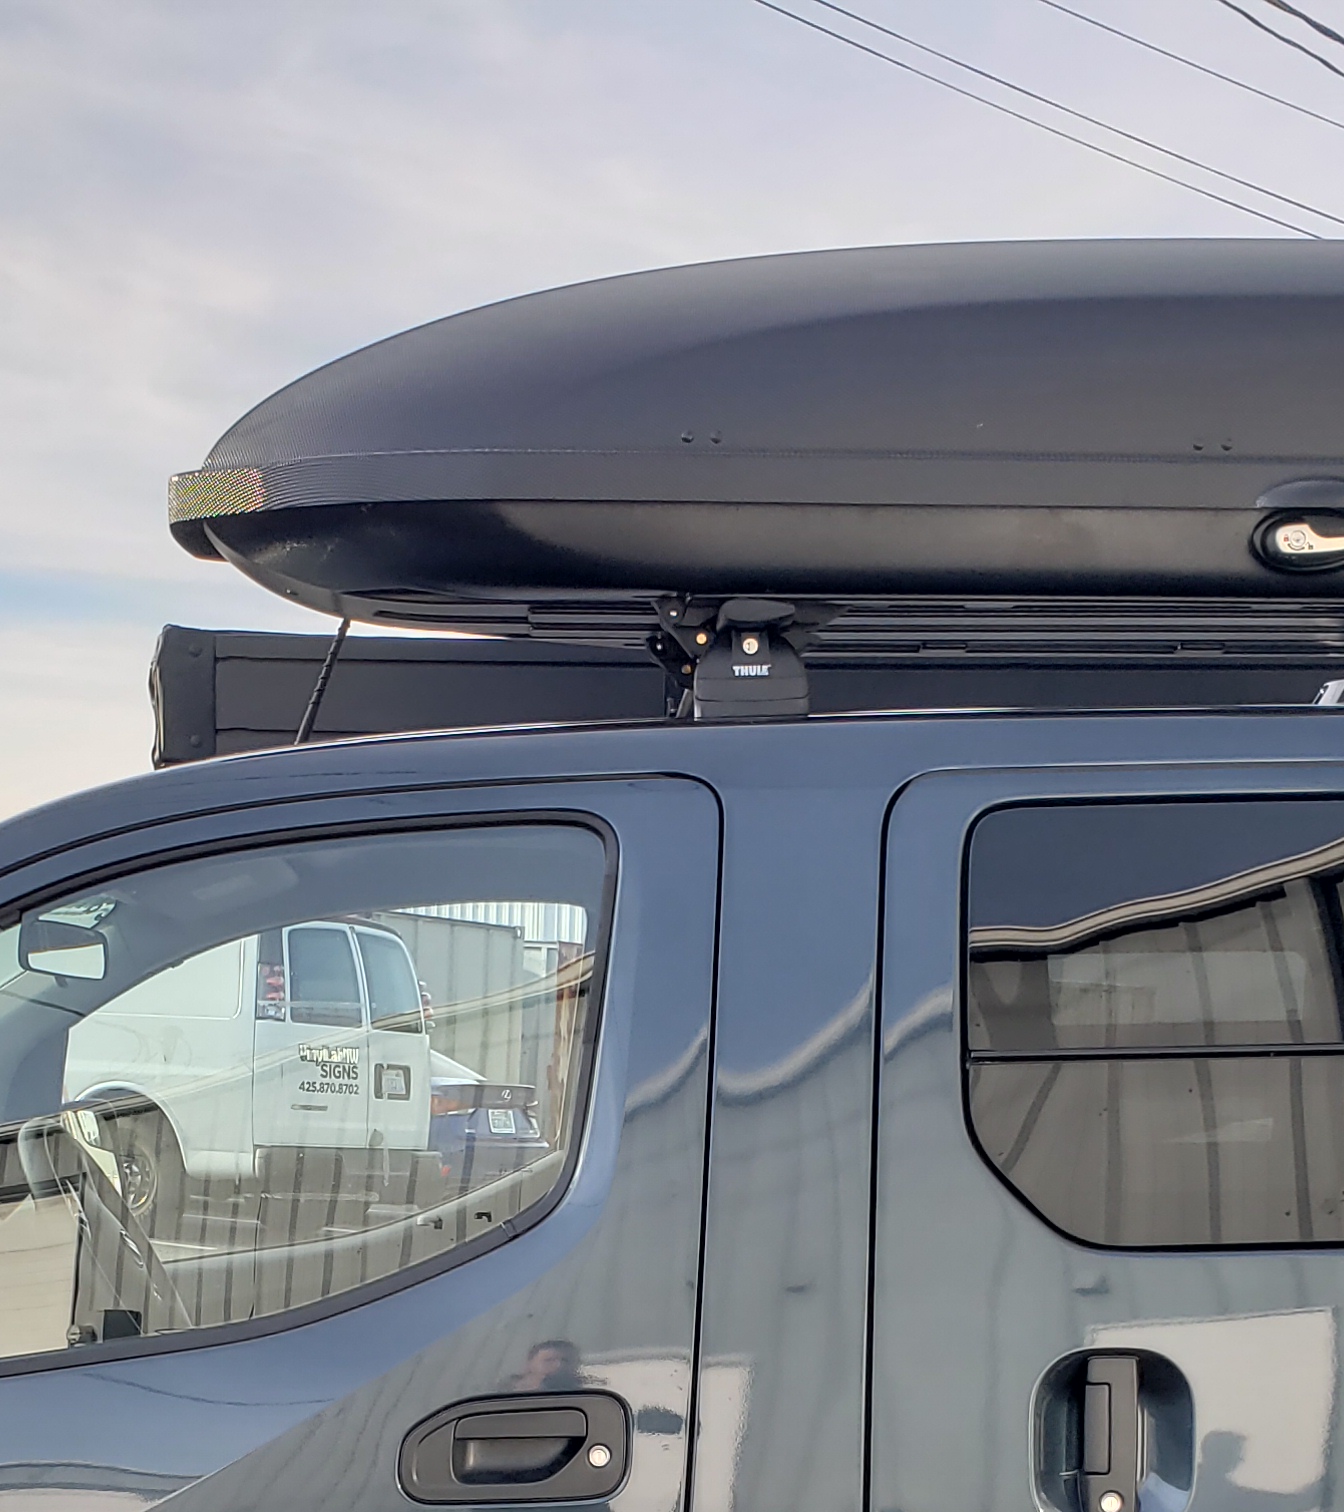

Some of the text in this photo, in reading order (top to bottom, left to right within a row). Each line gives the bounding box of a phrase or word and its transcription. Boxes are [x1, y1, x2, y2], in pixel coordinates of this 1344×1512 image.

[732, 664, 770, 677] THULE
[320, 1063, 359, 1081] SIGNS
[298, 1080, 360, 1096] 425.870.8702
